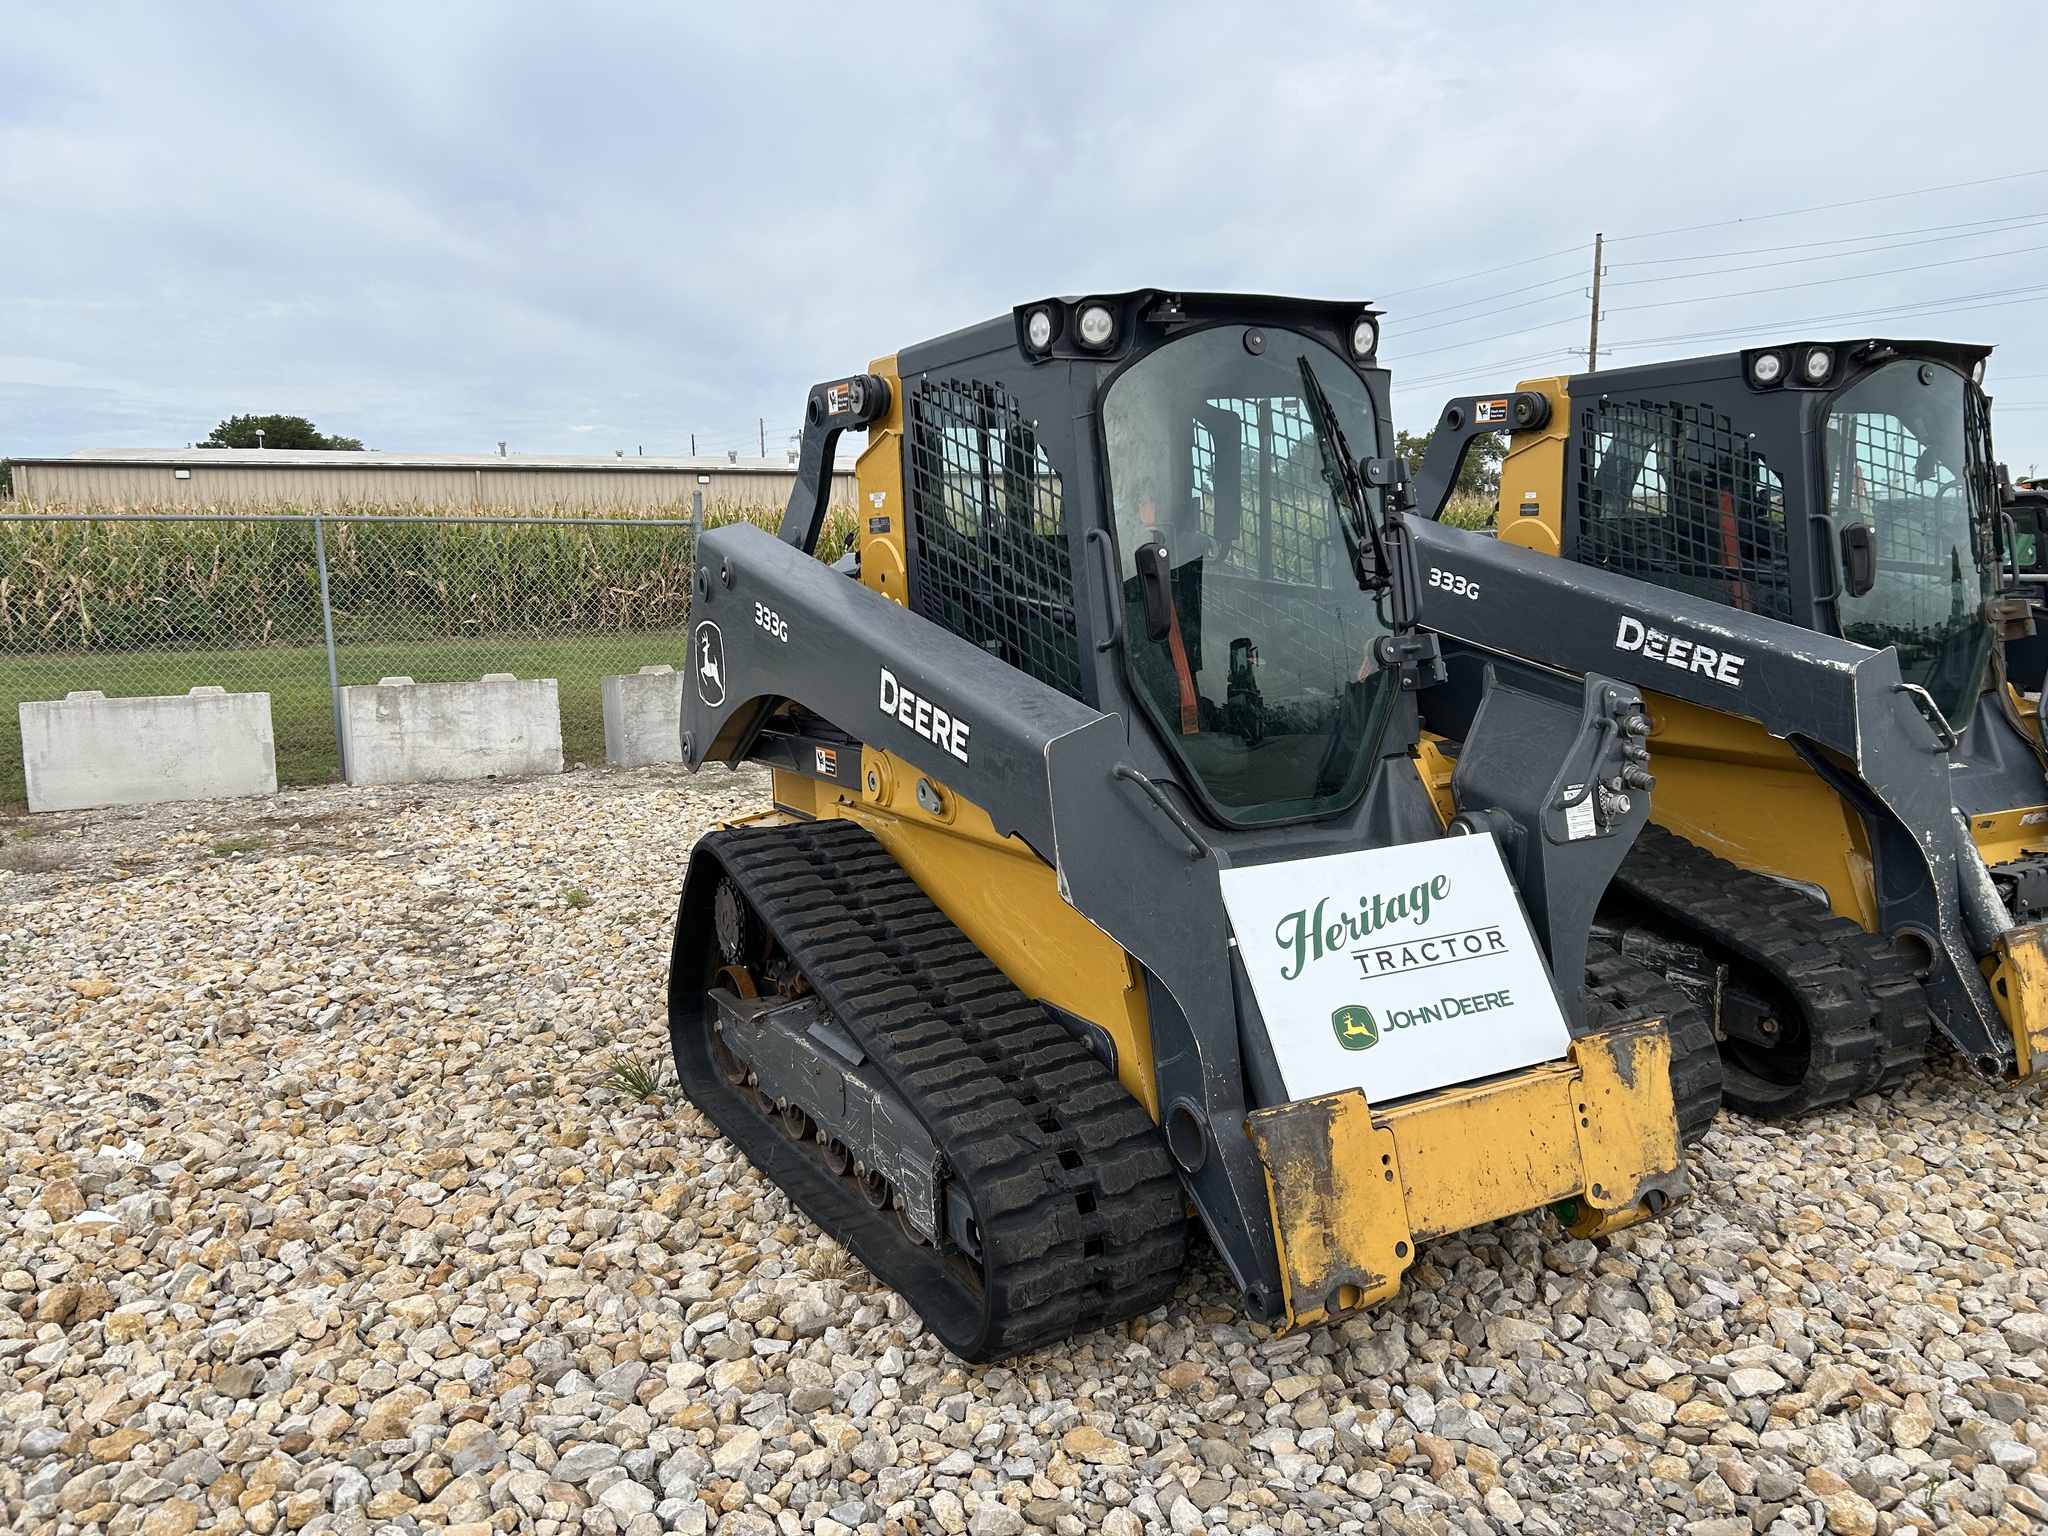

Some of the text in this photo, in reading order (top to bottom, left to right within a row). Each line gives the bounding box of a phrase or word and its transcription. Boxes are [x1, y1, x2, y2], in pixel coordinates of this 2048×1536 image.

[1428, 567, 1480, 600] 333G
[754, 601, 788, 643] 333G
[1615, 615, 1745, 686] DEERE
[879, 667, 970, 764] DEERE
[1275, 874, 1451, 981] Heritage
[1353, 930, 1506, 974] TRACTOR
[1383, 989, 1514, 1032] JOHN DEERE
